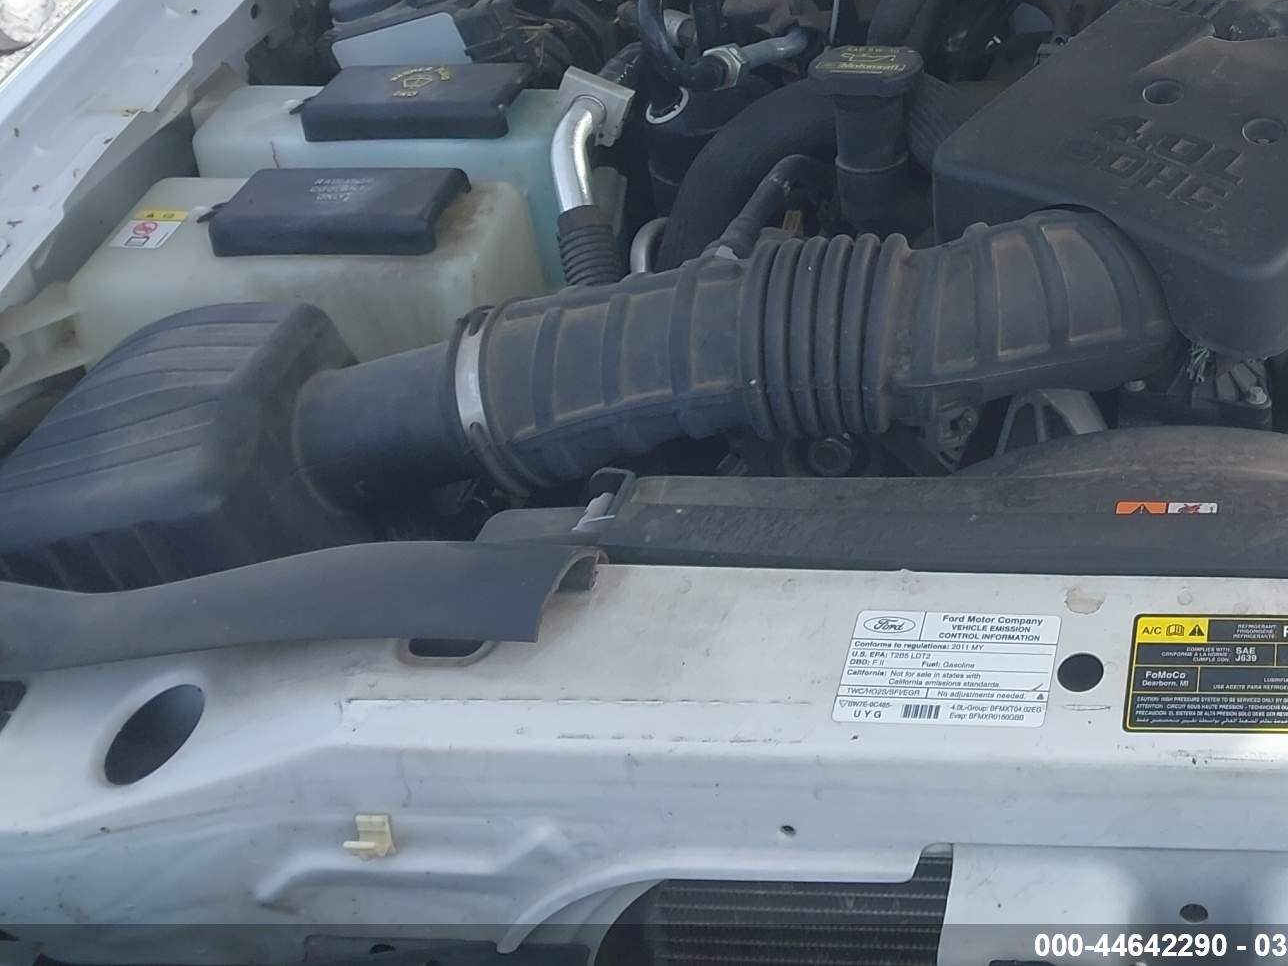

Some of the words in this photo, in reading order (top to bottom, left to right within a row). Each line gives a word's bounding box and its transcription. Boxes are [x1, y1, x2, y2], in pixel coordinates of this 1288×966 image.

[942, 615, 965, 623] Ford
[967, 615, 996, 624] Motor
[998, 616, 1044, 626] Company
[951, 624, 988, 632] VEHICLE
[990, 625, 1032, 633] EMISSION
[1142, 626, 1163, 635] A/C
[938, 632, 980, 640] CONTROL
[981, 633, 1041, 642] INFORMATION
[1145, 670, 1187, 679] FoMoCo
[949, 691, 995, 699] adjustments
[853, 710, 862, 718] U
[873, 710, 882, 719] G
